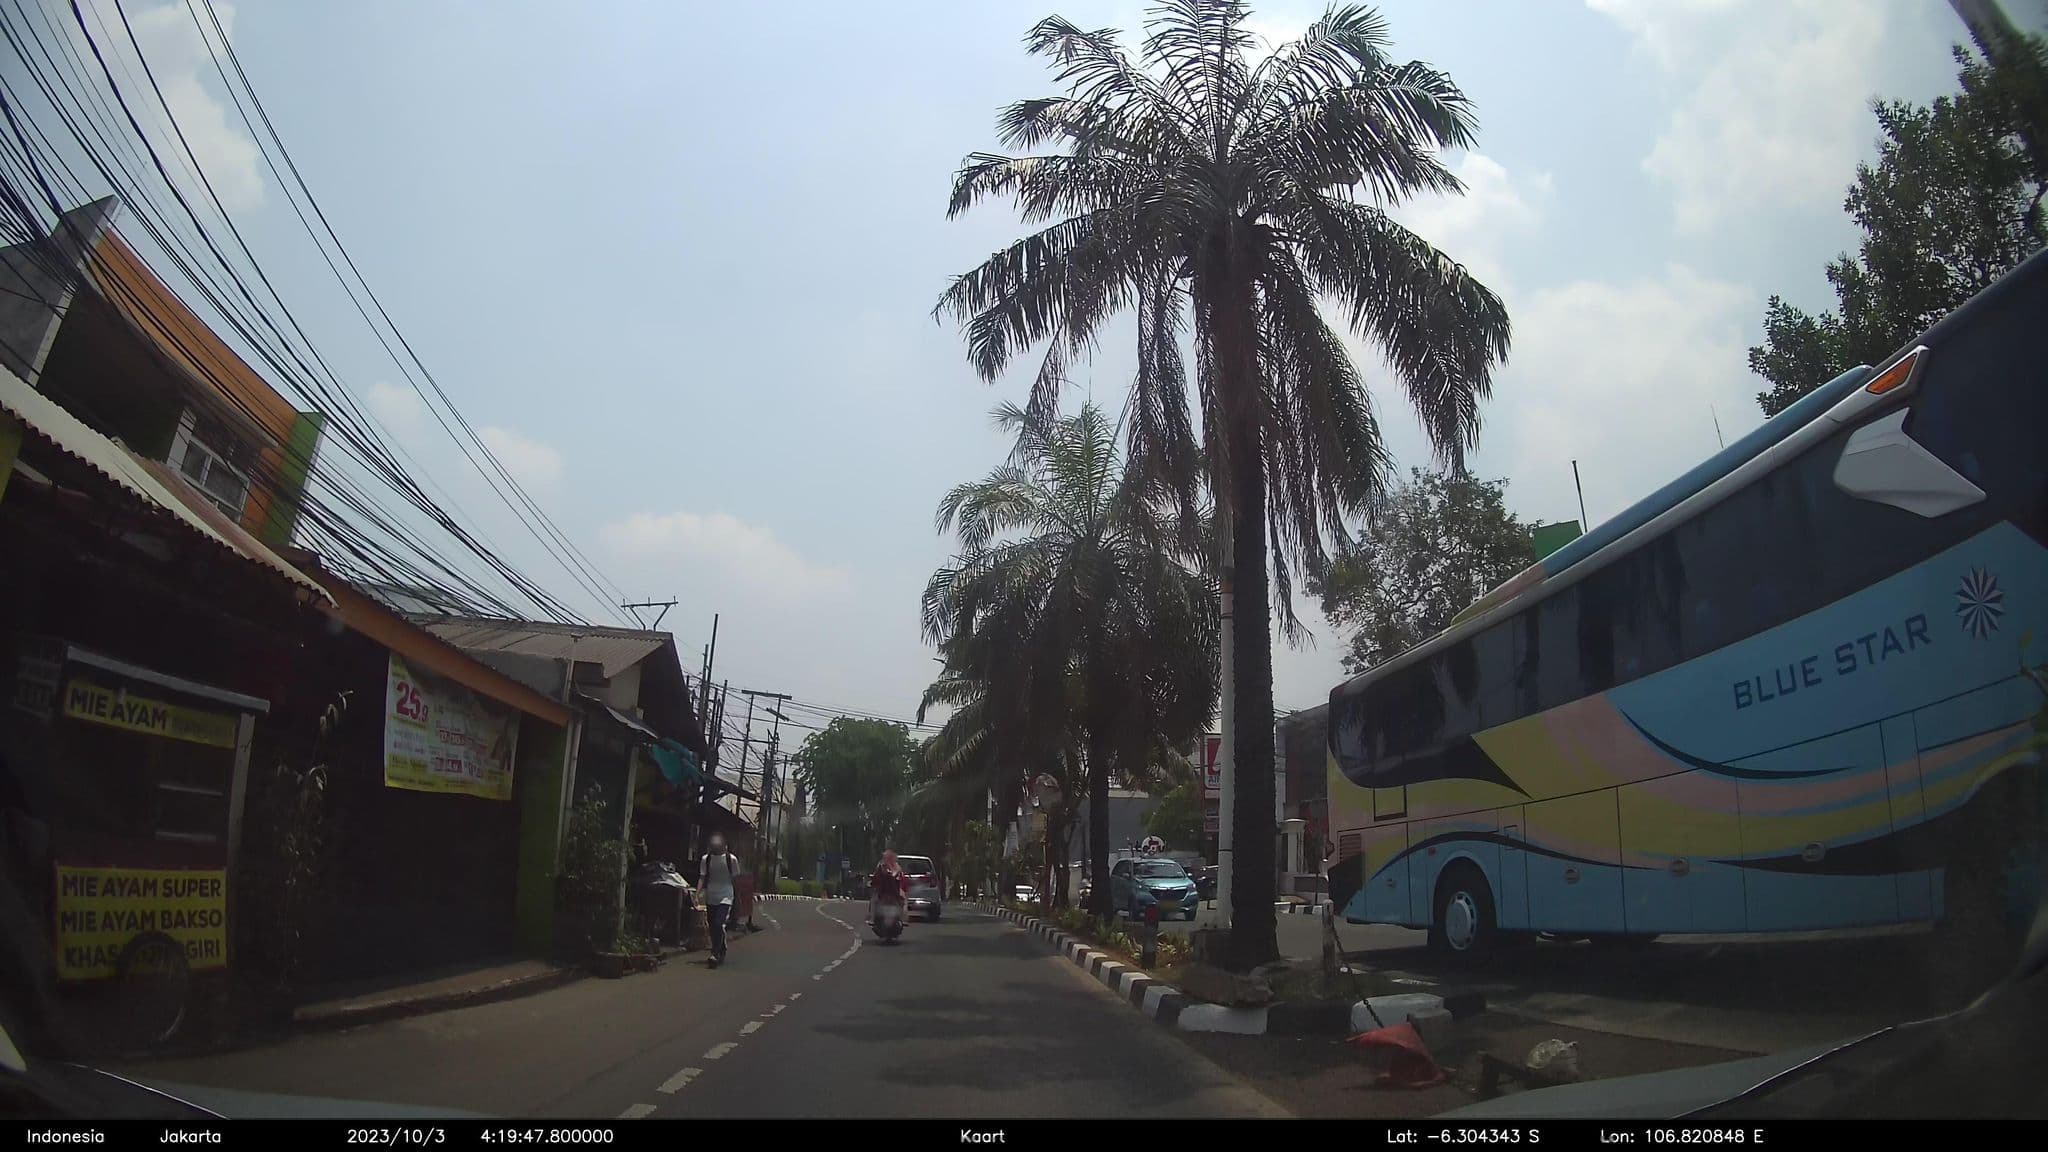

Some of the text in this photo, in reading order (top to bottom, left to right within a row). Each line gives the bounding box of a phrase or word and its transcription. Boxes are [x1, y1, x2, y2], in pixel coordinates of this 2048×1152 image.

[1733, 613, 1932, 710] BLUE STAR
[69, 688, 108, 719] MIE
[111, 701, 167, 730] AYAM
[62, 875, 221, 898] MIE AYAM SUPER
[61, 909, 222, 932] MIE AYAM BAKSO
